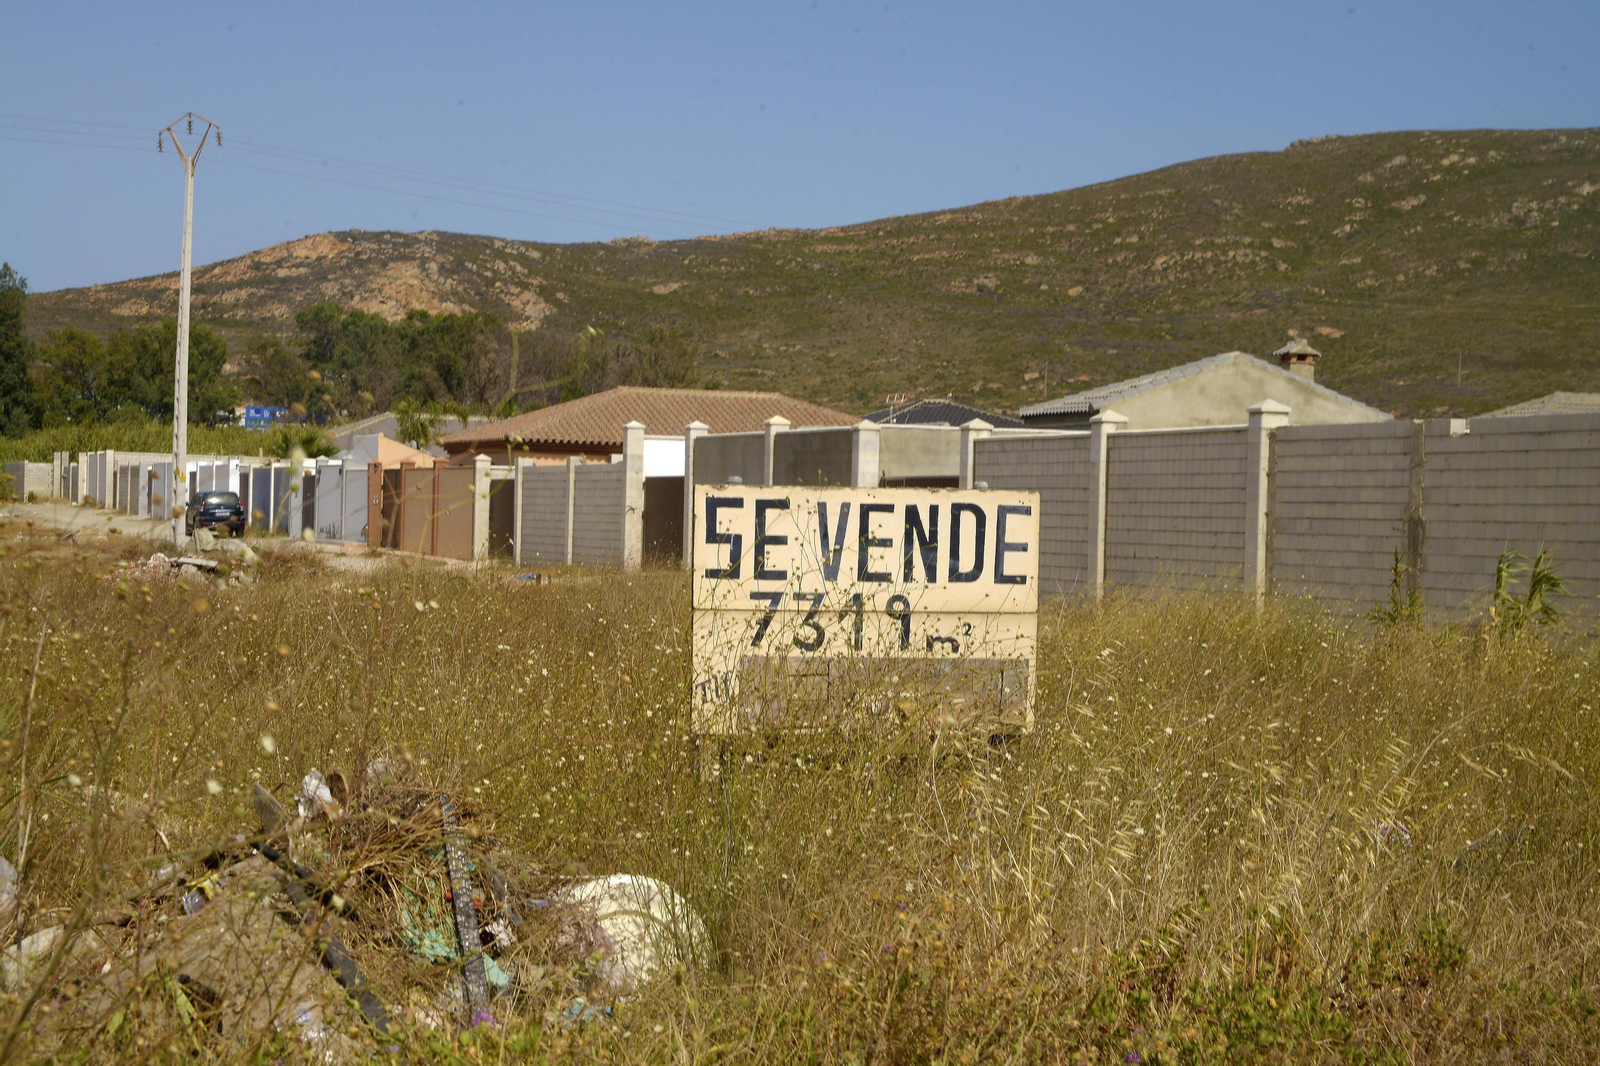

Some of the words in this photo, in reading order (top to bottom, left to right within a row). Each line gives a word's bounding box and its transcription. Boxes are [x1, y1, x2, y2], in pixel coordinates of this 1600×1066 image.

[705, 497, 791, 581] SE
[816, 501, 1032, 584] VENDE
[750, 592, 911, 651] 7319
